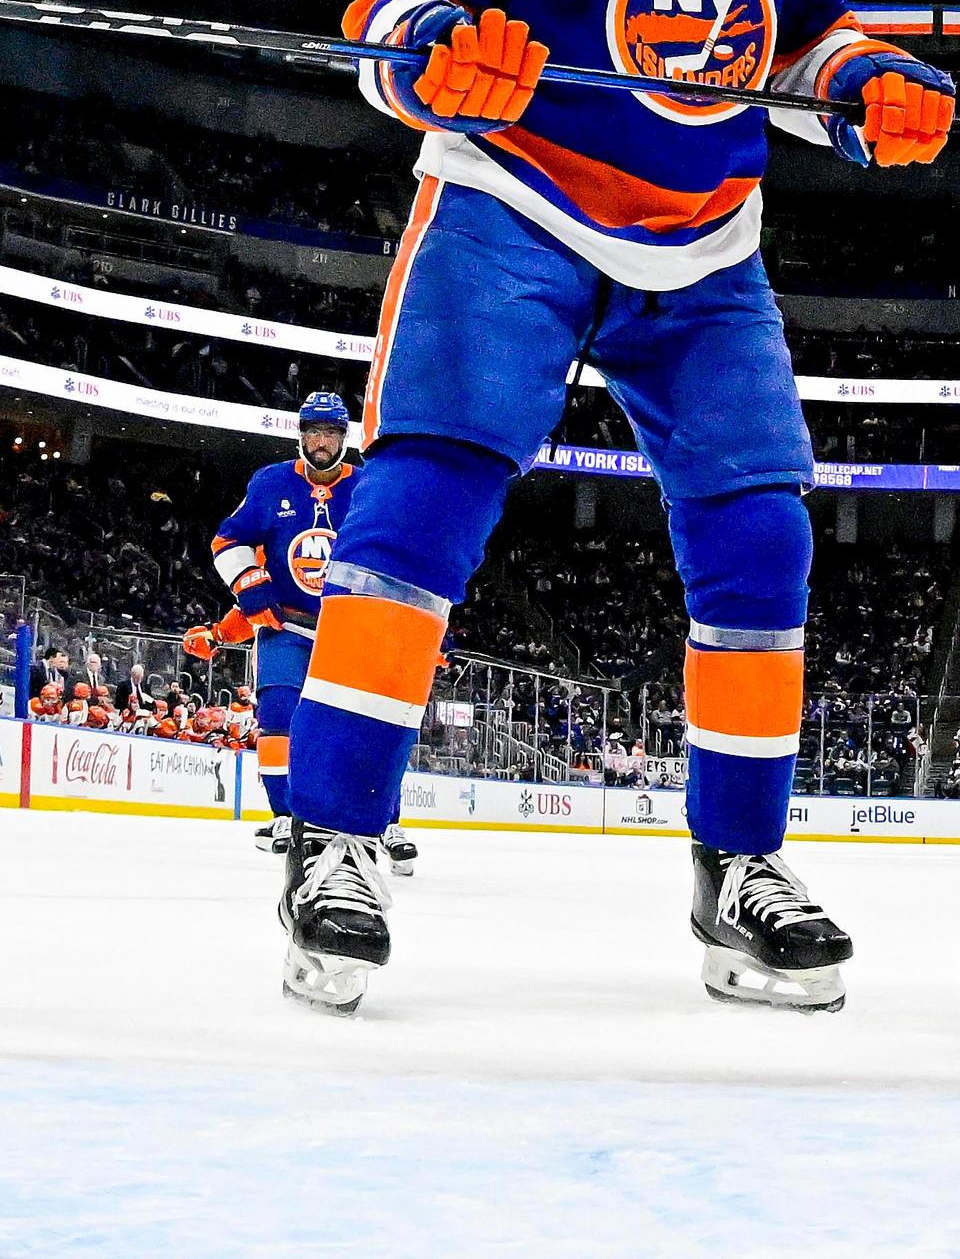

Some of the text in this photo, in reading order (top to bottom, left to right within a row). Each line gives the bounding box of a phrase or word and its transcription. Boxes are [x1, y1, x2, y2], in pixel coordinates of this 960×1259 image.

[171, 204, 237, 231] GILLIES
[64, 289, 84, 305] UBS
[158, 308, 181, 324] UBS
[255, 324, 277, 341] UBS
[350, 340, 373, 355] UBS
[78, 381, 100, 397] UBS
[852, 385, 876, 397] UBS
[276, 416, 300, 431] UBS
[574, 450, 618, 472] YORK
[66, 739, 118, 786] Coca-Cola
[537, 793, 572, 817] UBS
[849, 804, 916, 828] jetBlue
